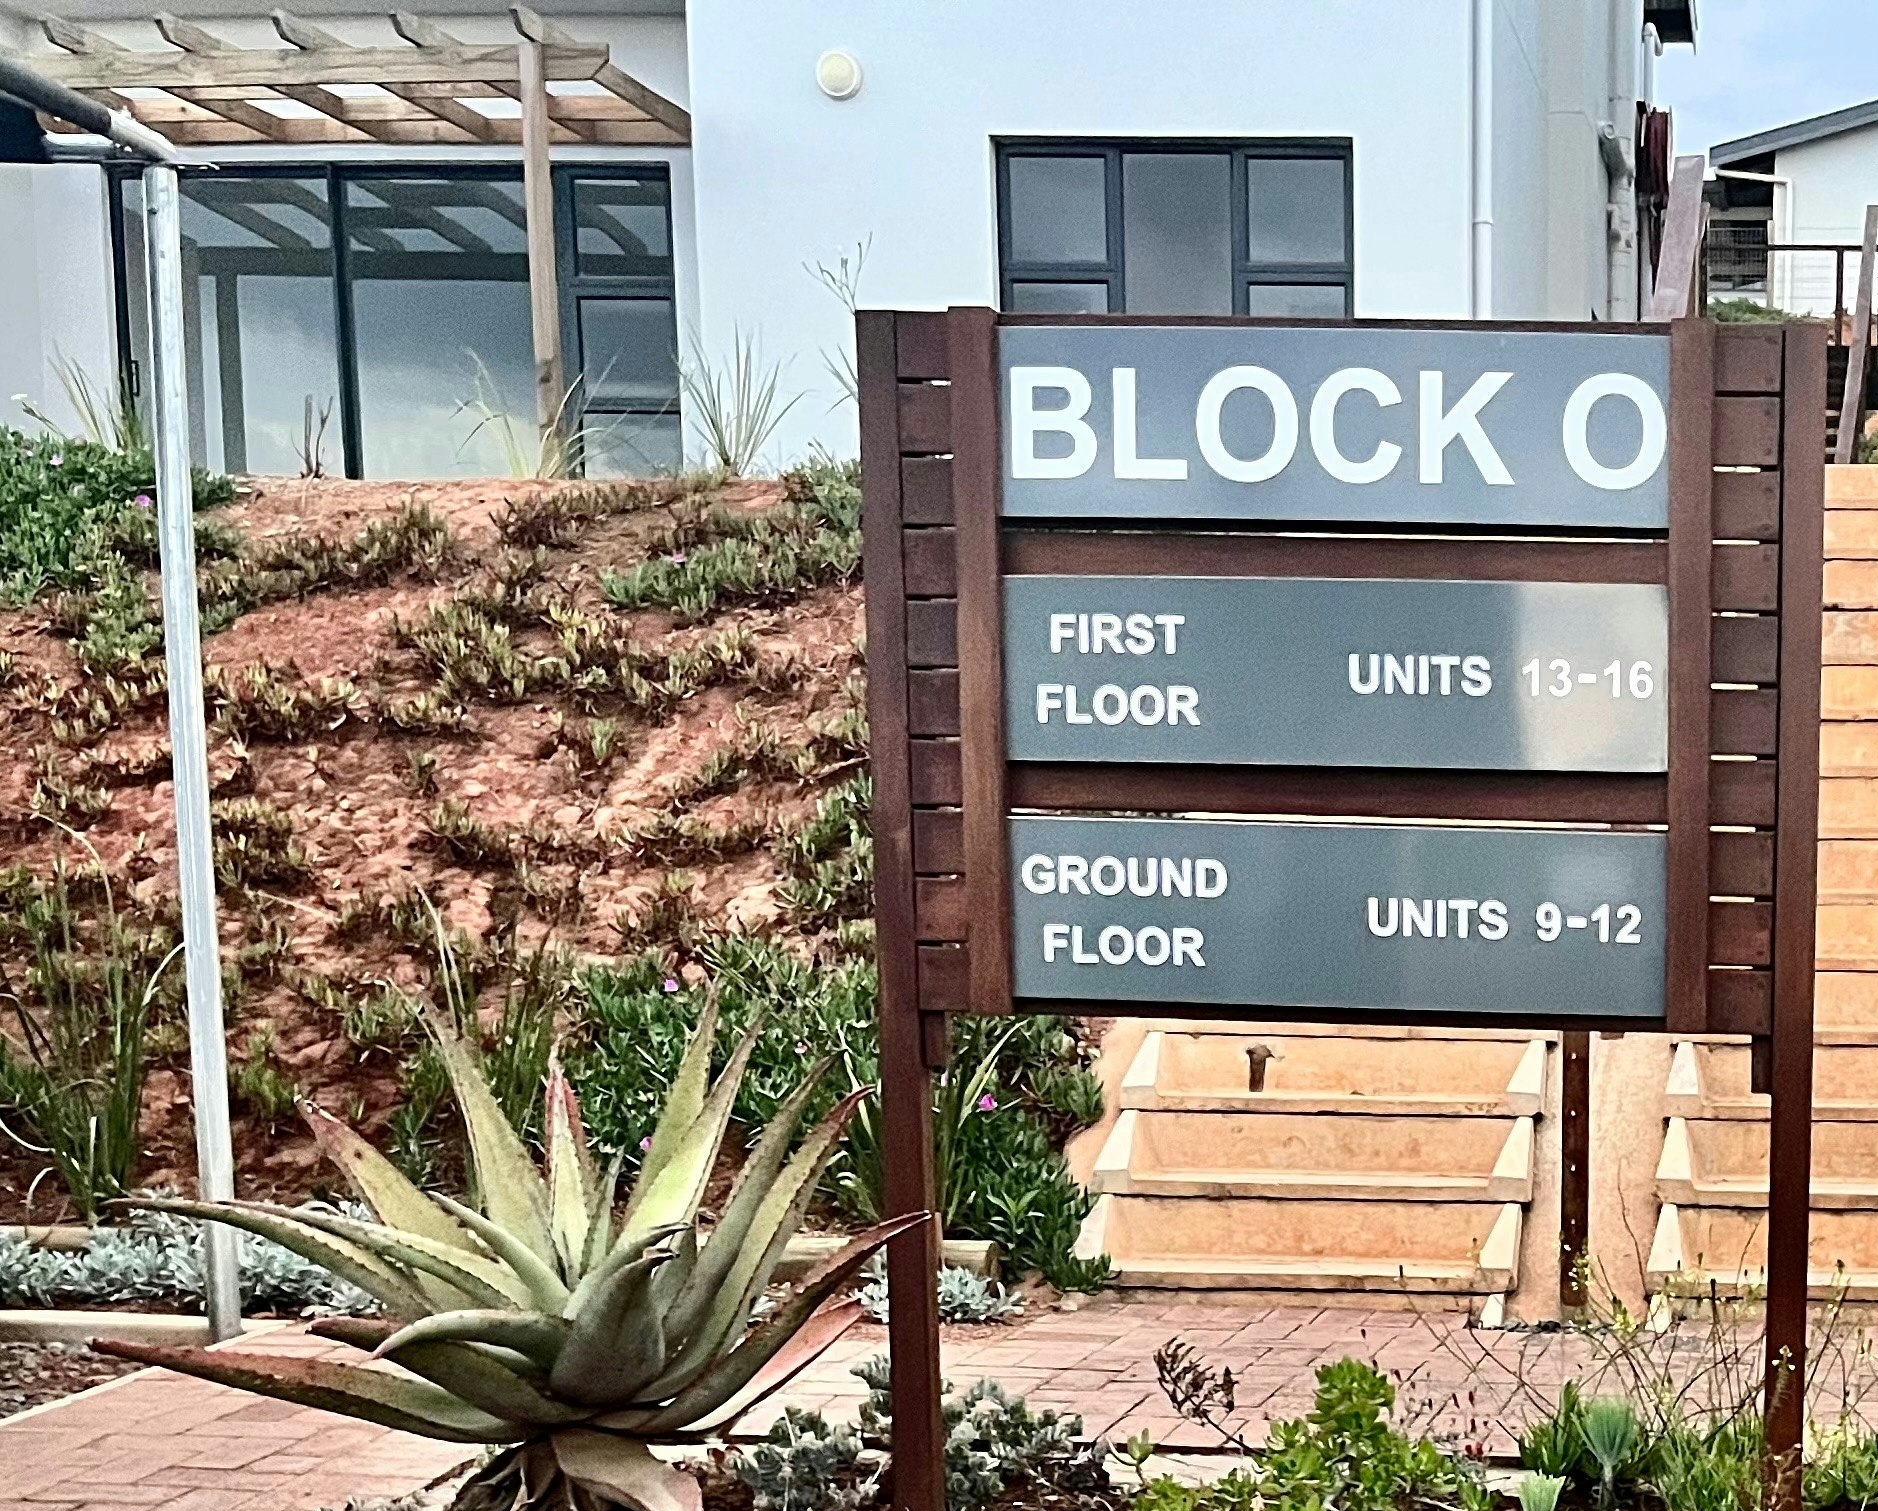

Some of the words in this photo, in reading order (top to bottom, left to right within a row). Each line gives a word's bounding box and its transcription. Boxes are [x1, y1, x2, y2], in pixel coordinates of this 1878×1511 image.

[1008, 363, 1515, 488] BLOCK
[1561, 371, 1668, 490] O
[1049, 613, 1186, 656] FIRST
[1347, 653, 1493, 697] UNITS
[1521, 658, 1655, 700] 13-16
[1036, 684, 1202, 727] FLOOR
[1020, 854, 1229, 899] GROUND
[1366, 898, 1510, 942] UNITS
[1535, 902, 1642, 945] 9-12
[1042, 924, 1206, 967] FLOOR
